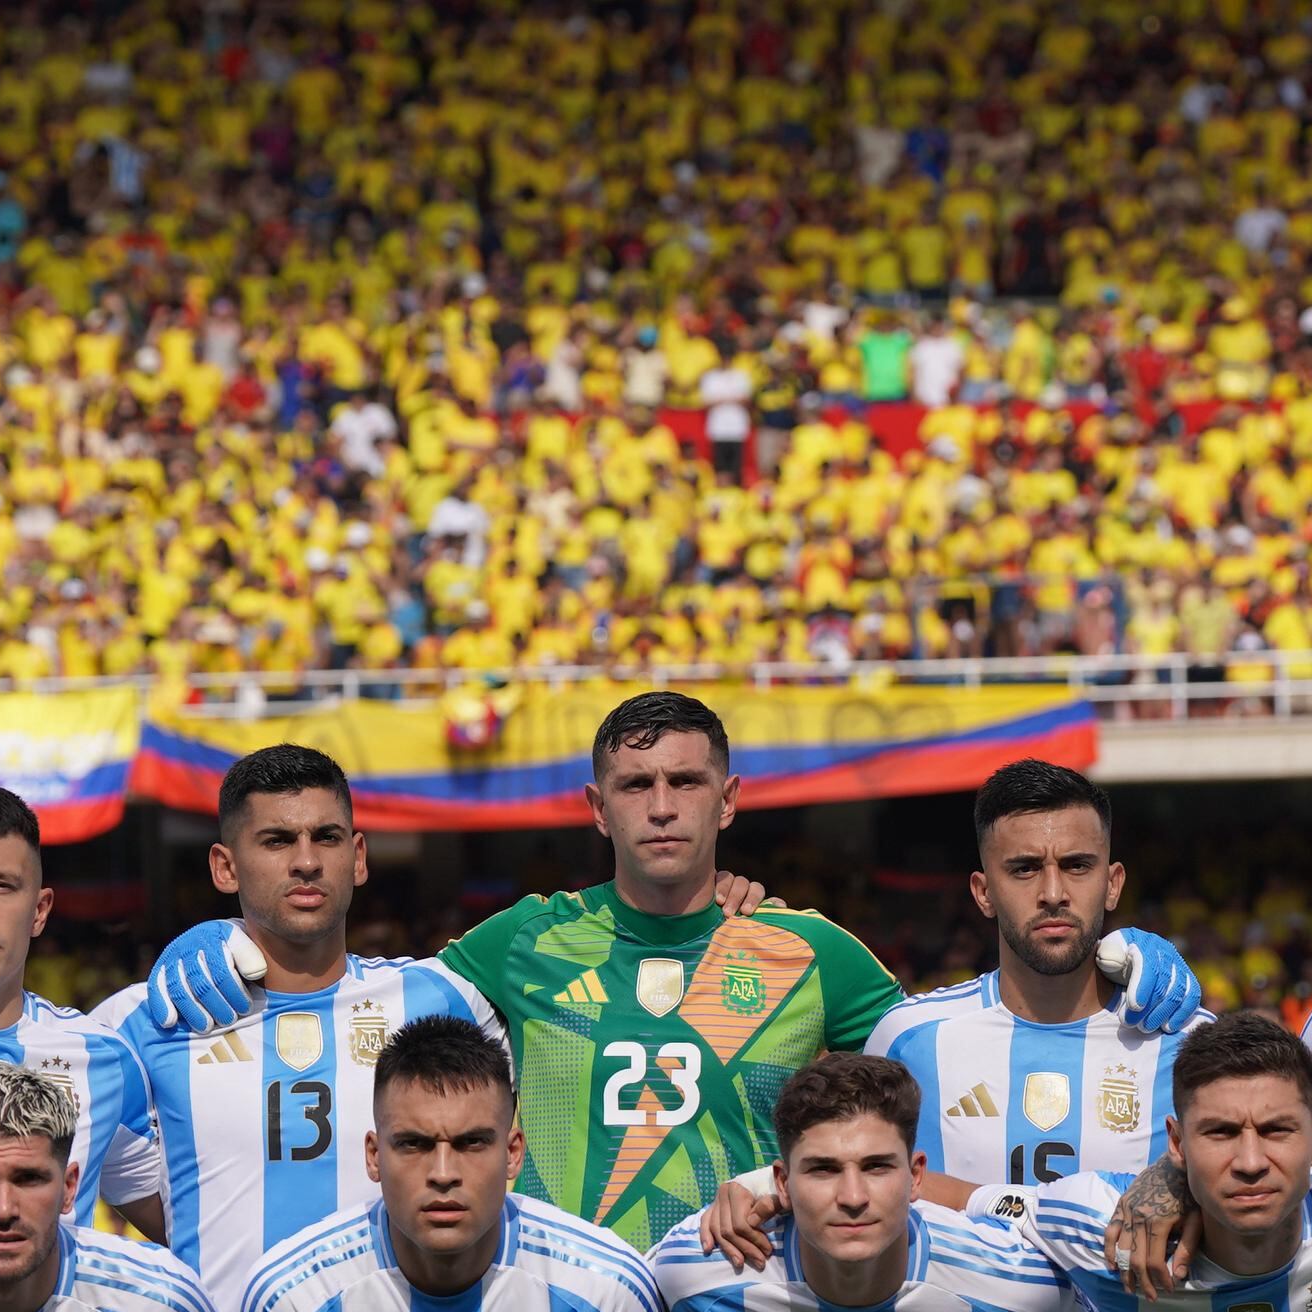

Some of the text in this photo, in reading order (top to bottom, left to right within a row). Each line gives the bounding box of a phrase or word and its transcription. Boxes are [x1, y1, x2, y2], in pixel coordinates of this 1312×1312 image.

[730, 977, 758, 1001] AFA
[359, 1029, 382, 1053] AFA
[603, 1041, 701, 1126] 23
[1105, 1093, 1131, 1118] AFA
[267, 1081, 332, 1161] 13
